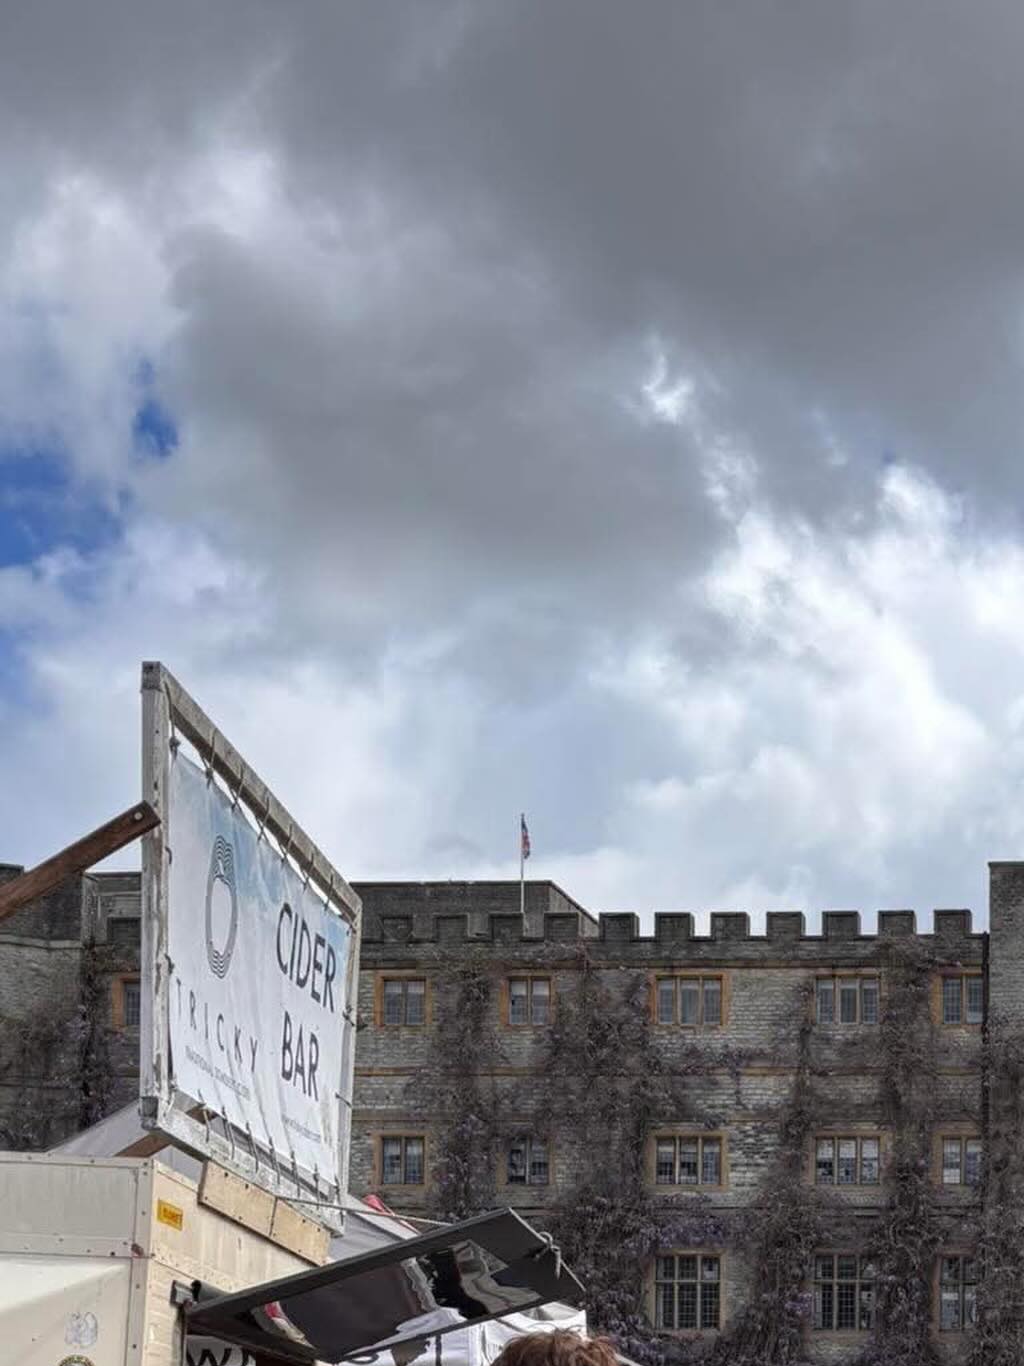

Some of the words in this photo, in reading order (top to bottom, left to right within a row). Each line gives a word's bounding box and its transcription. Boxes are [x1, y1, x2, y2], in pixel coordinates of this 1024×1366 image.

[276, 902, 337, 1013] CIDER
[175, 977, 258, 1073] TRICKY
[281, 1010, 319, 1102] BAR
